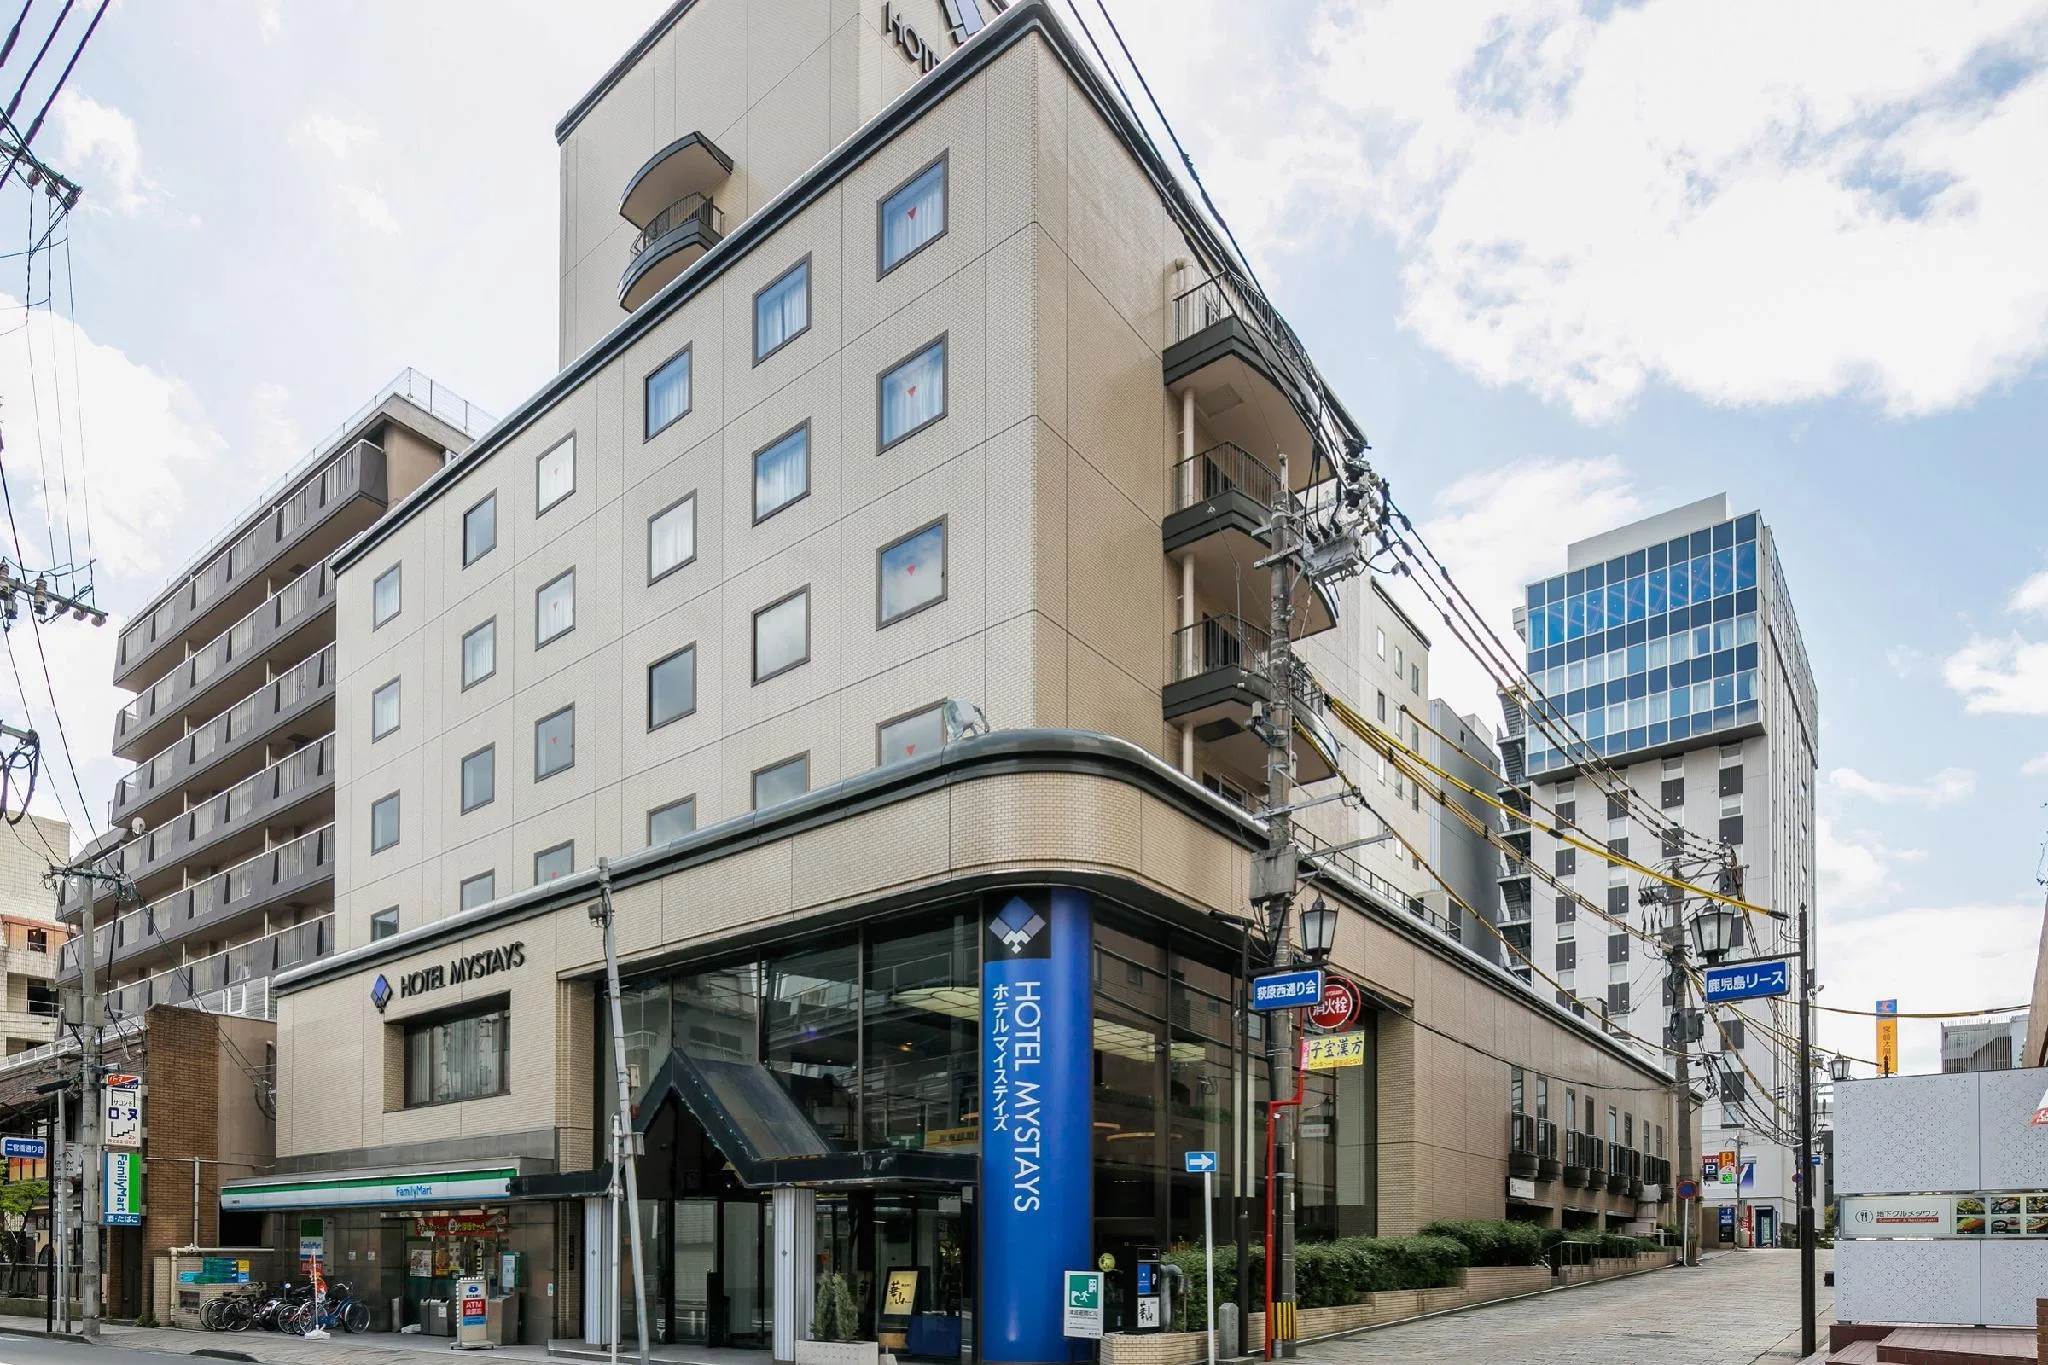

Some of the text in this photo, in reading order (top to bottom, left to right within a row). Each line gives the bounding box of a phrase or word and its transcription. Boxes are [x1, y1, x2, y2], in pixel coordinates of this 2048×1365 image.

[885, 1, 940, 73] HOT
[401, 941, 525, 998] HOTEL MYSTAYS
[1708, 971, 1784, 993] 鹿児島リース
[1312, 996, 1348, 1016] 消火栓
[992, 983, 1009, 1132] ホテルマイステイズ
[1311, 1037, 1363, 1059] 子宝漢方
[1013, 981, 1041, 1212] HOTEL MYSTAYS
[114, 1154, 128, 1212] FamilyMart
[396, 1186, 432, 1198] FamilyMart
